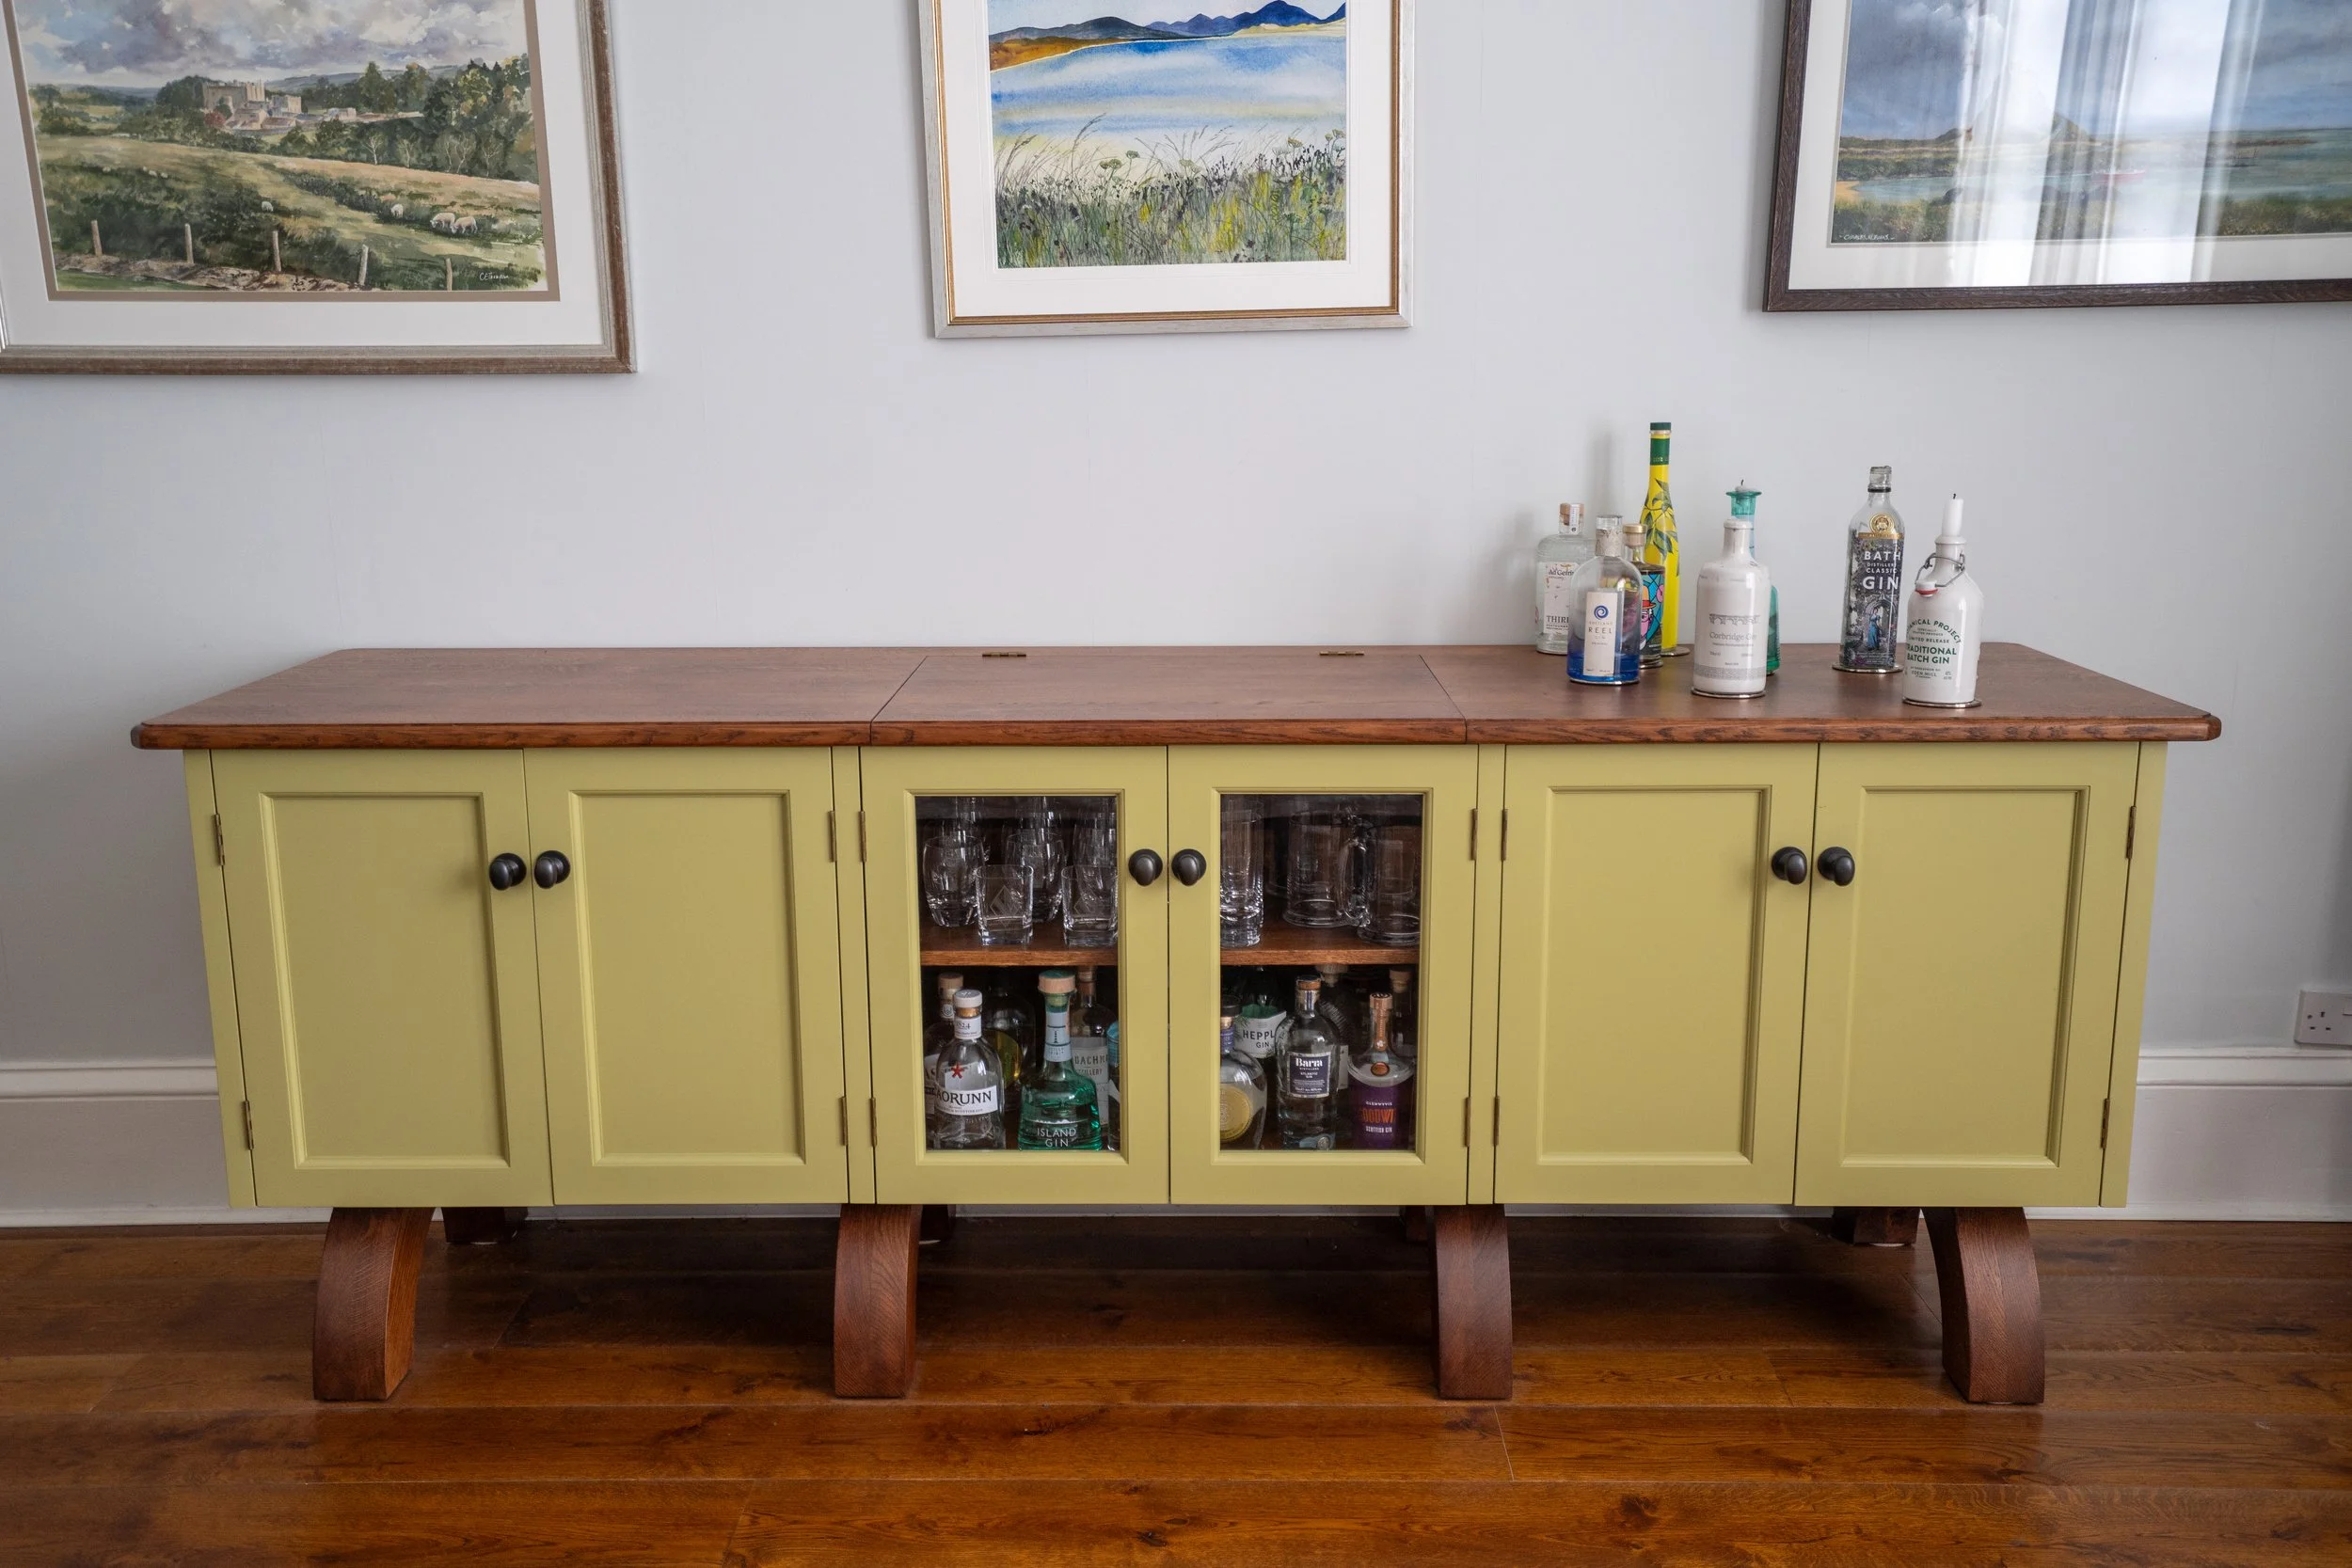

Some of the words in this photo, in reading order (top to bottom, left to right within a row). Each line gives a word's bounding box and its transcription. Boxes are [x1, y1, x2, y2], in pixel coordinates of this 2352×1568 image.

[1864, 551, 1900, 561] BATH
[1863, 576, 1899, 590] GIN
[1709, 631, 1744, 642] Corbridge
[1933, 620, 1962, 643] PROJECT
[1907, 653, 1930, 663] BATCH
[1931, 656, 1950, 664] GIN
[1243, 1029, 1276, 1040] HEPPL
[1295, 1057, 1323, 1068] Barra
[937, 1090, 992, 1106] AORUNN
[1037, 1128, 1076, 1137] ISLAND
[1045, 1138, 1069, 1148] GIN
